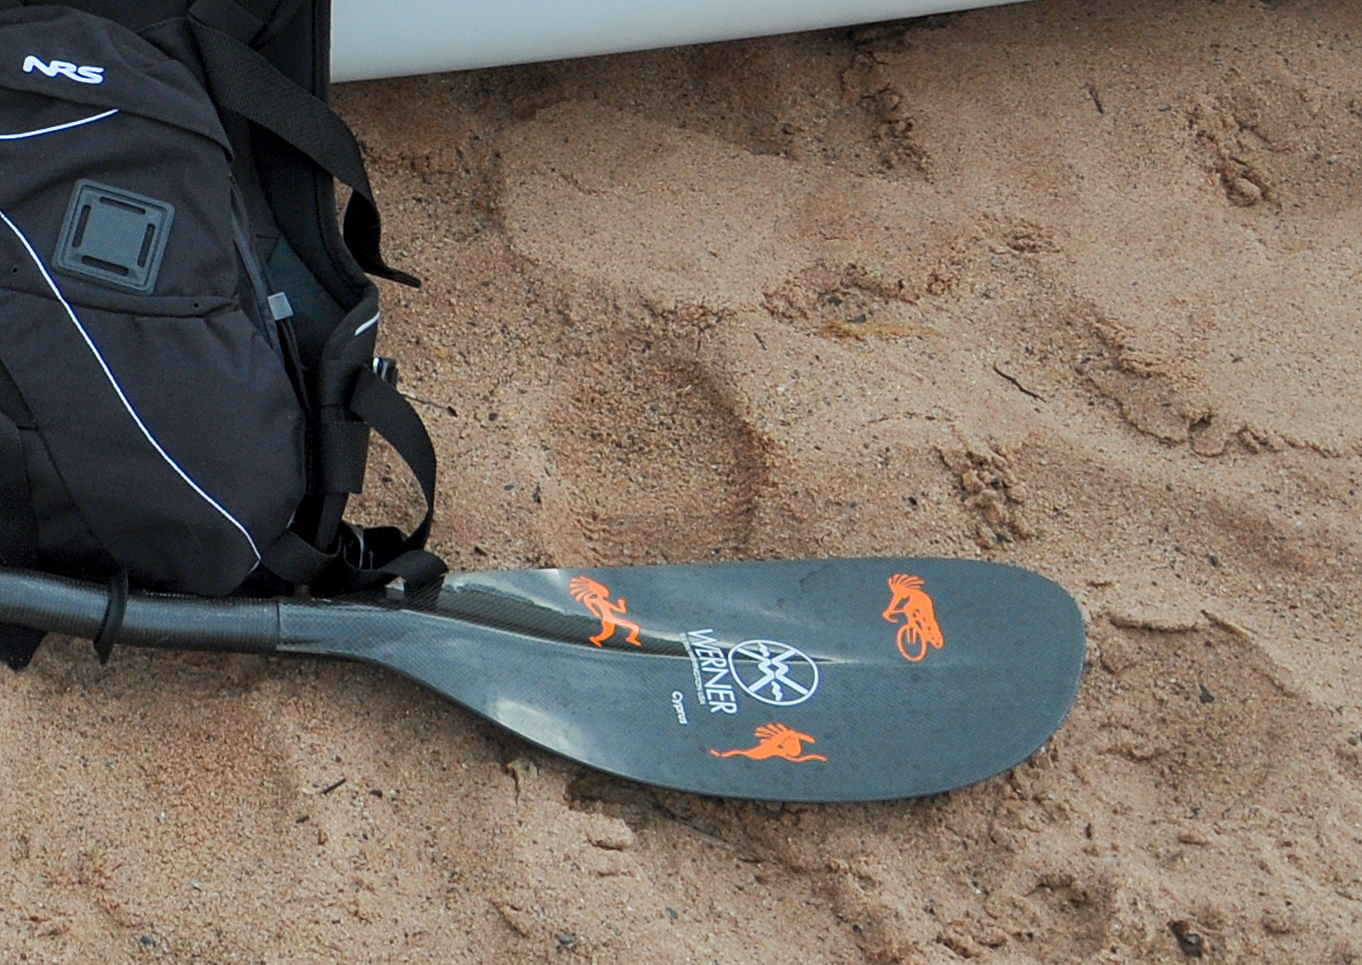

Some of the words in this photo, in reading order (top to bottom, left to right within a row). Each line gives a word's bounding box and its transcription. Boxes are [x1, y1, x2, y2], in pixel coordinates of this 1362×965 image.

[23, 55, 105, 84] NRS
[686, 628, 738, 714] WERNER
[671, 691, 688, 725] Cyprus
